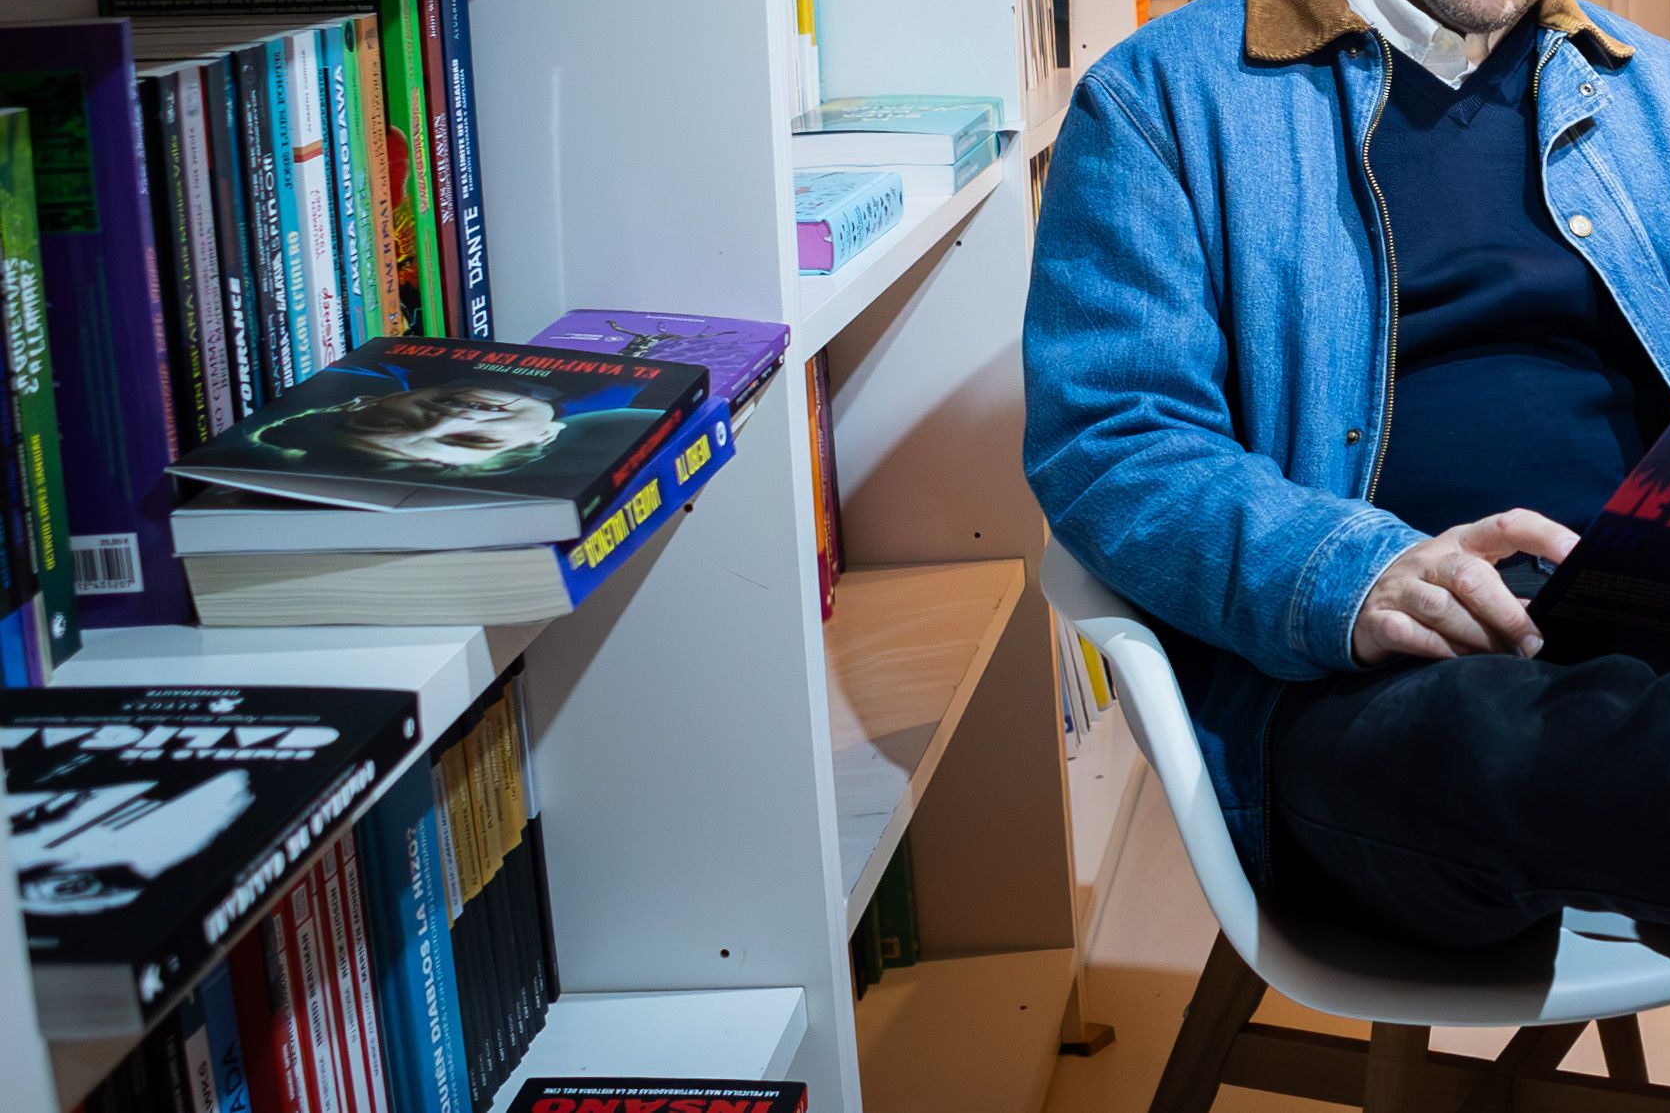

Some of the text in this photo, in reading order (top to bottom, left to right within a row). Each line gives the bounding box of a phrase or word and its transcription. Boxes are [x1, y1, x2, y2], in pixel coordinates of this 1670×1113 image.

[333, 64, 362, 296] AKIRA KUROSAWA
[463, 206, 489, 338] JOE DANTE
[228, 276, 250, 417] TORRANCE
[384, 343, 448, 357] CINE
[405, 826, 425, 899] HIZO?
[414, 901, 429, 938] LA
[419, 939, 444, 1044] DIABLOS
